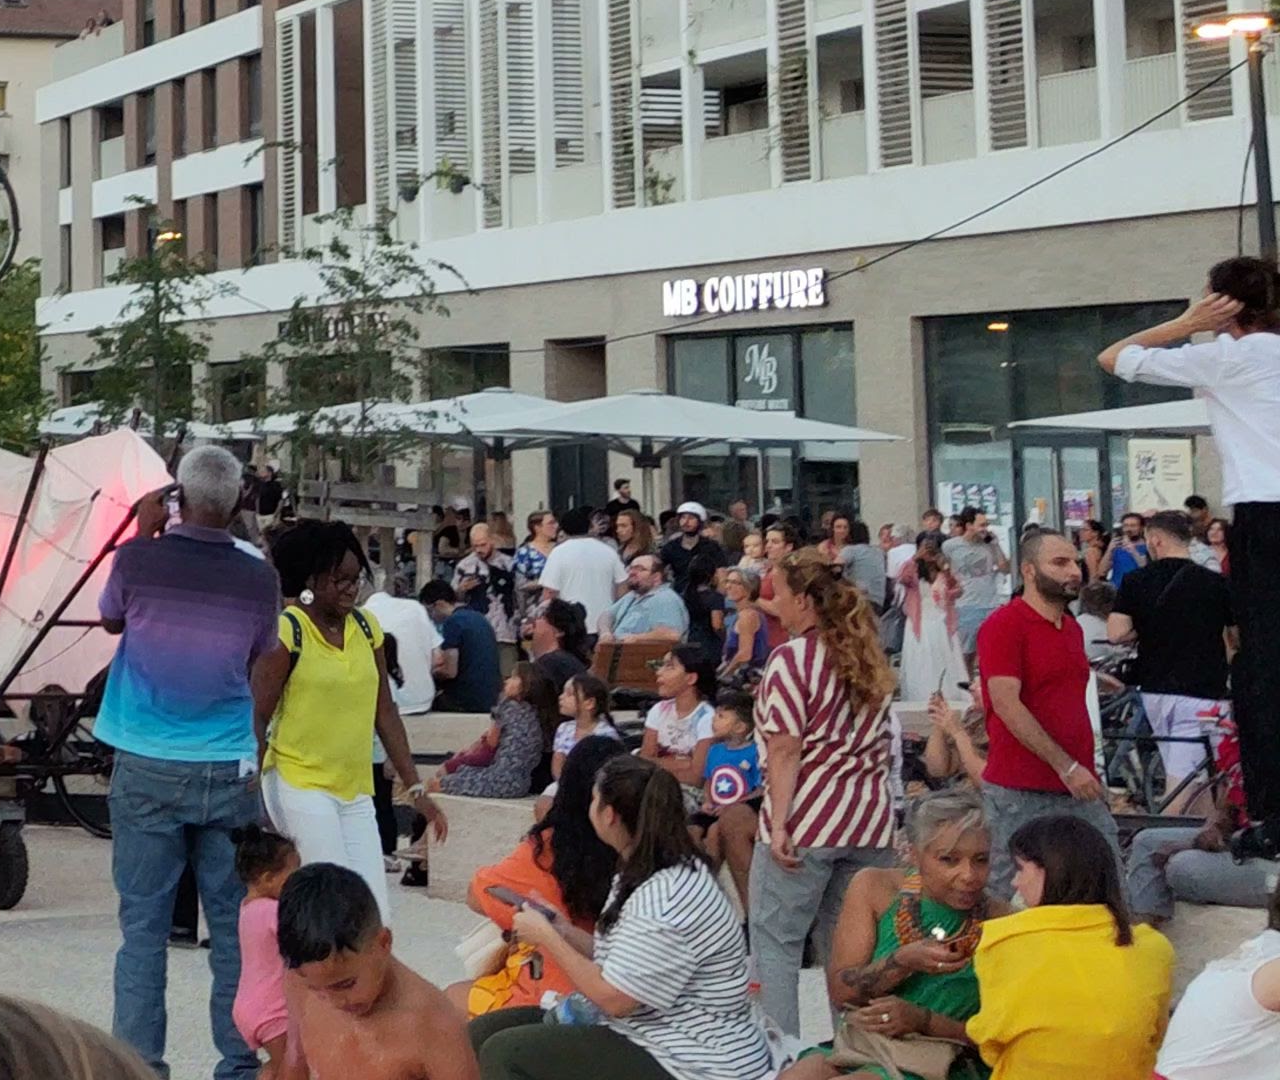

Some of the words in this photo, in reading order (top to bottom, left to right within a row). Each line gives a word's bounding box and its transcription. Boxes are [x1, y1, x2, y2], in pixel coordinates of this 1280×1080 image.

[663, 279, 698, 317] MB
[703, 267, 825, 313] COIFFURE
[743, 342, 778, 394] MB
